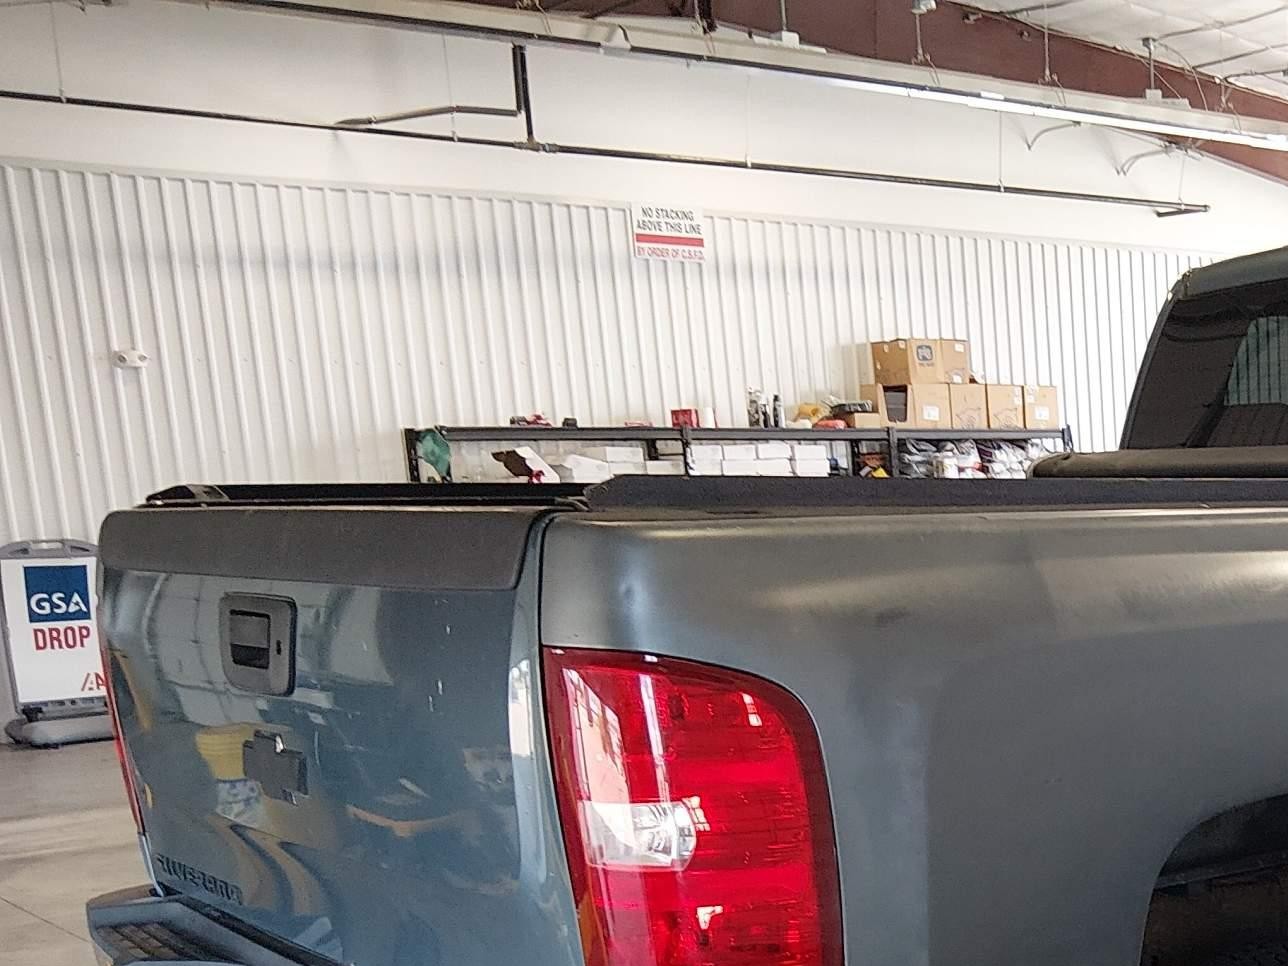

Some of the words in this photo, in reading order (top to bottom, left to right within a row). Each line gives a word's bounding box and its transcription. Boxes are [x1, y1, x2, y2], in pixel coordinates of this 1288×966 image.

[641, 206, 654, 218] NO
[655, 208, 694, 221] STACKING
[637, 219, 663, 232] ABOVE
[665, 221, 682, 234] THIS
[684, 223, 703, 235] LINE
[30, 592, 88, 615] GSA
[33, 625, 91, 651] DROP
